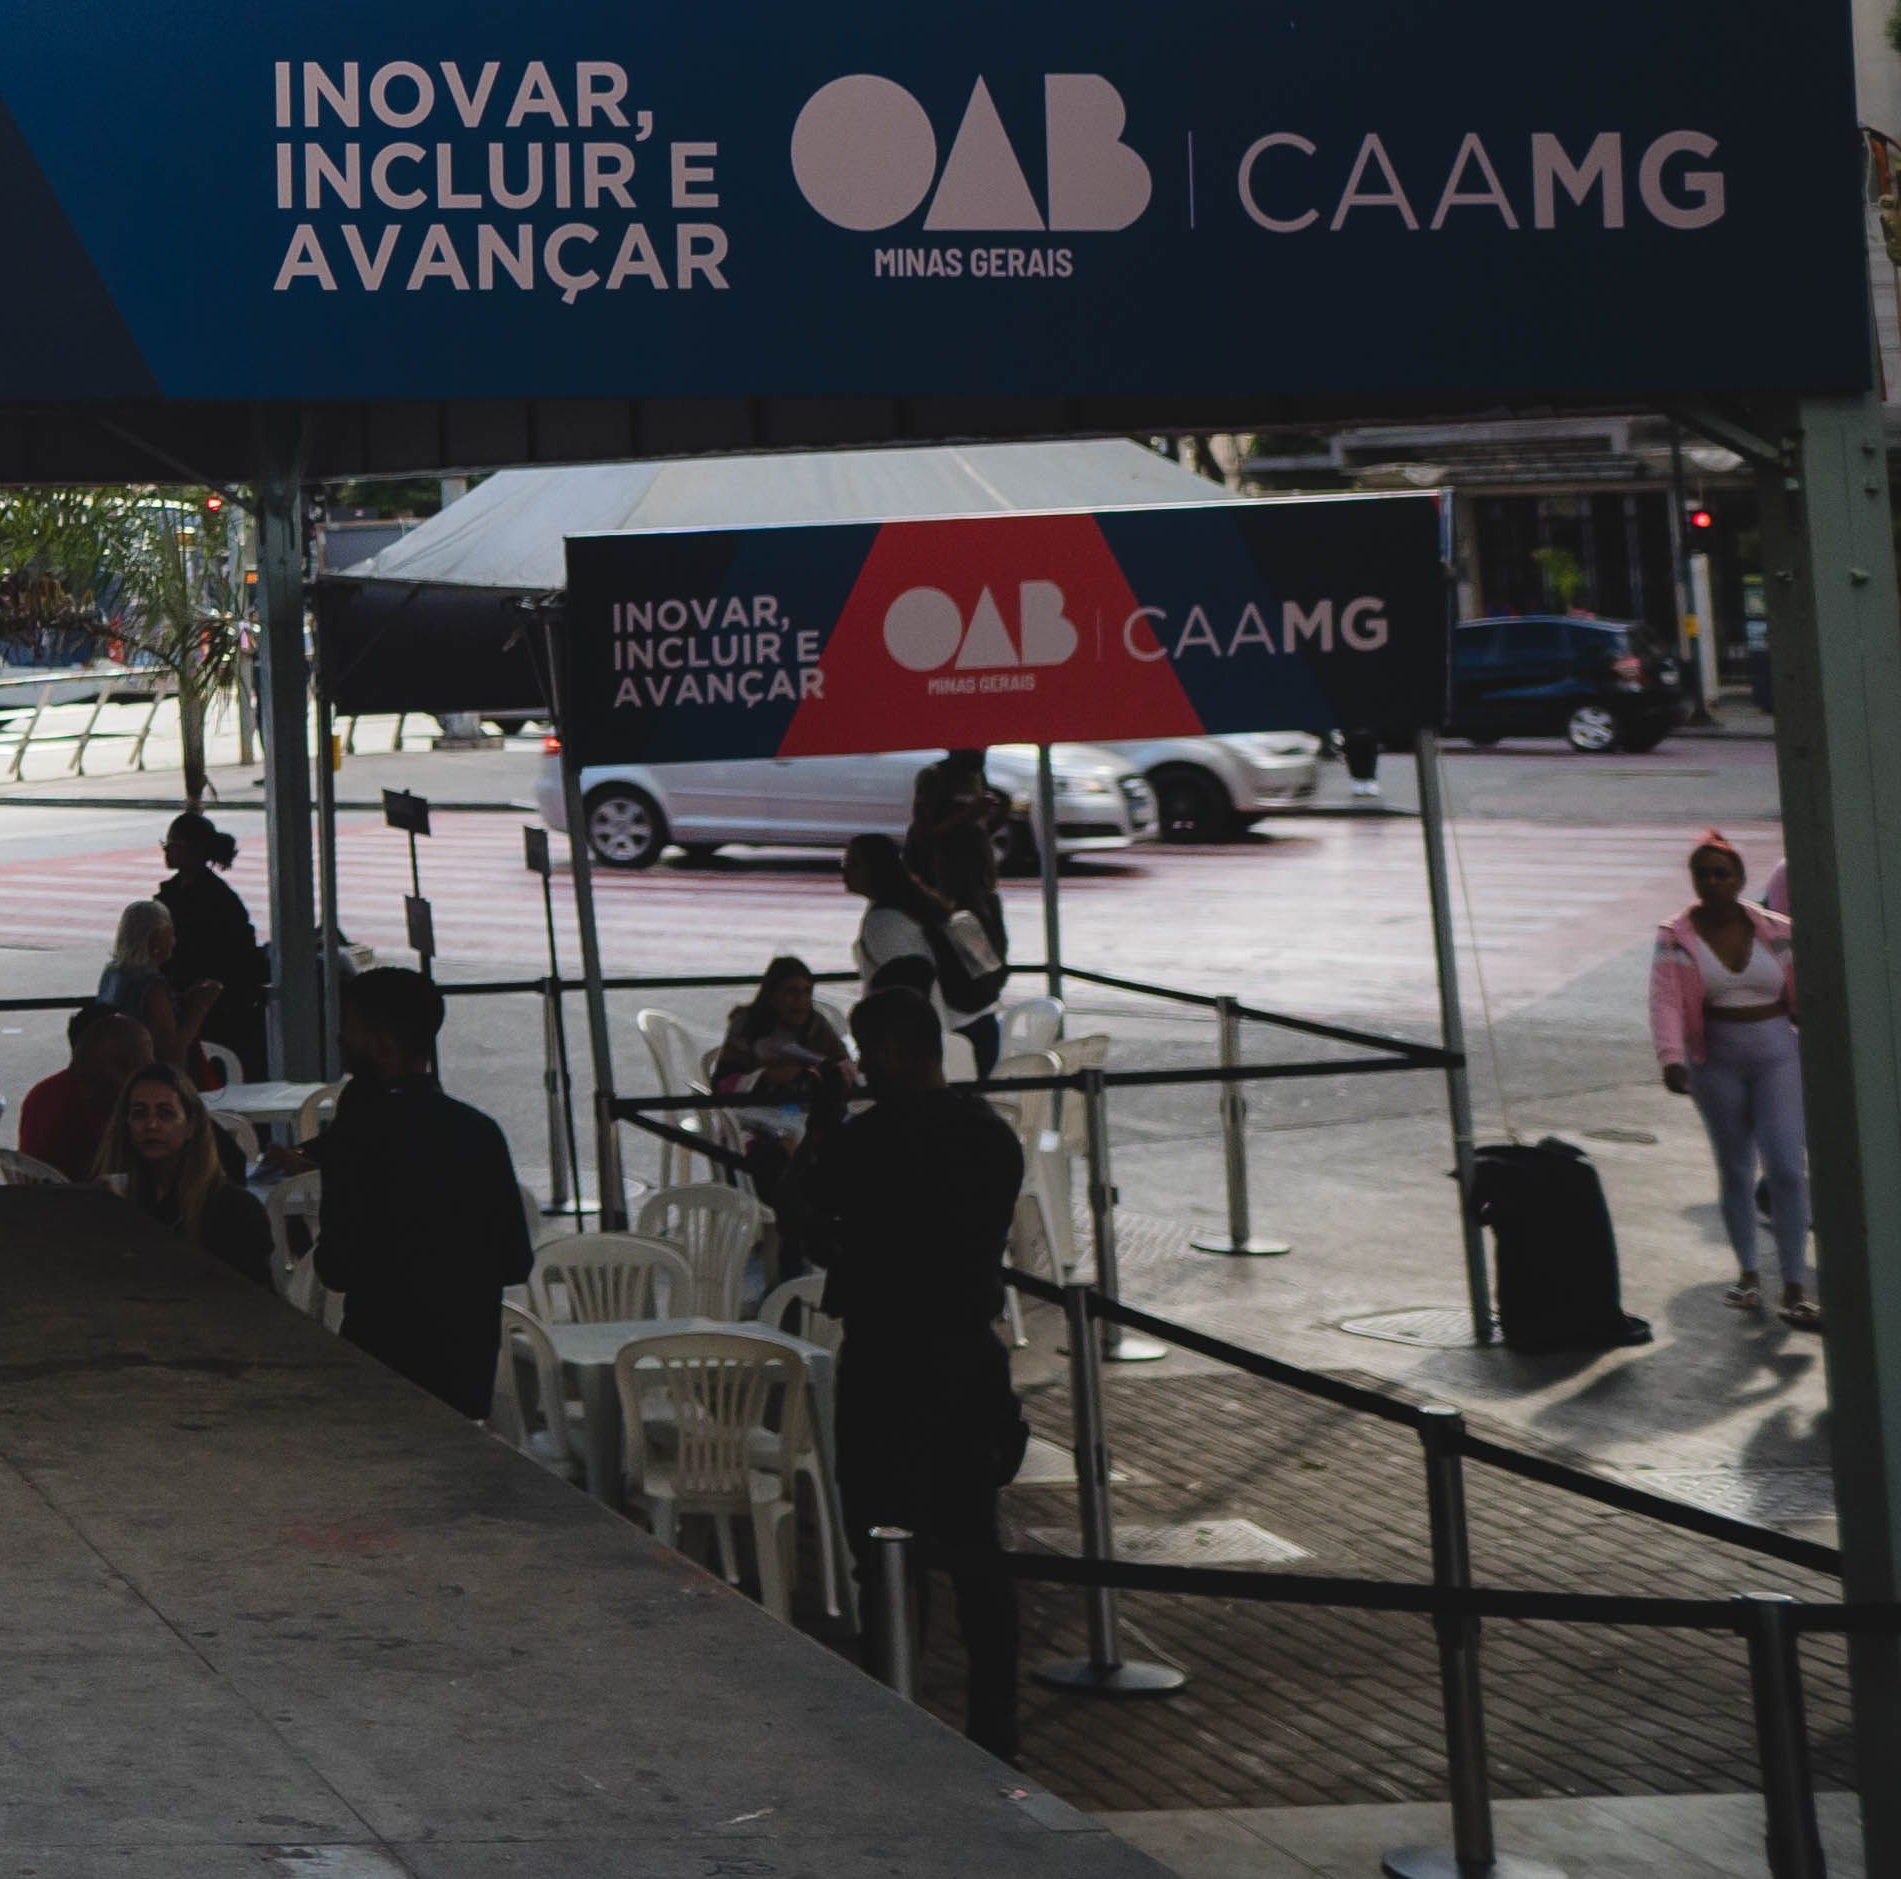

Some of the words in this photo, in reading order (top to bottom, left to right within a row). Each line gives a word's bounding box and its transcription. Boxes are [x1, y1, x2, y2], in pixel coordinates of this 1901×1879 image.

[275, 61, 653, 142] INOVAR,
[276, 143, 638, 209] INCLUIR
[670, 142, 719, 208] E
[791, 74, 1152, 231] OAB
[1238, 131, 1725, 232] CAAMG
[273, 223, 729, 304] AVANÇAR
[875, 248, 962, 277] MINAS
[970, 248, 1073, 277] GERAIS
[613, 595, 790, 633] INOVAR,
[883, 579, 1078, 670] OAB
[1123, 598, 1388, 662] CAAMG
[613, 633, 781, 669] INCLUIR
[797, 630, 819, 663] E
[614, 667, 824, 709] AVANÇAR
